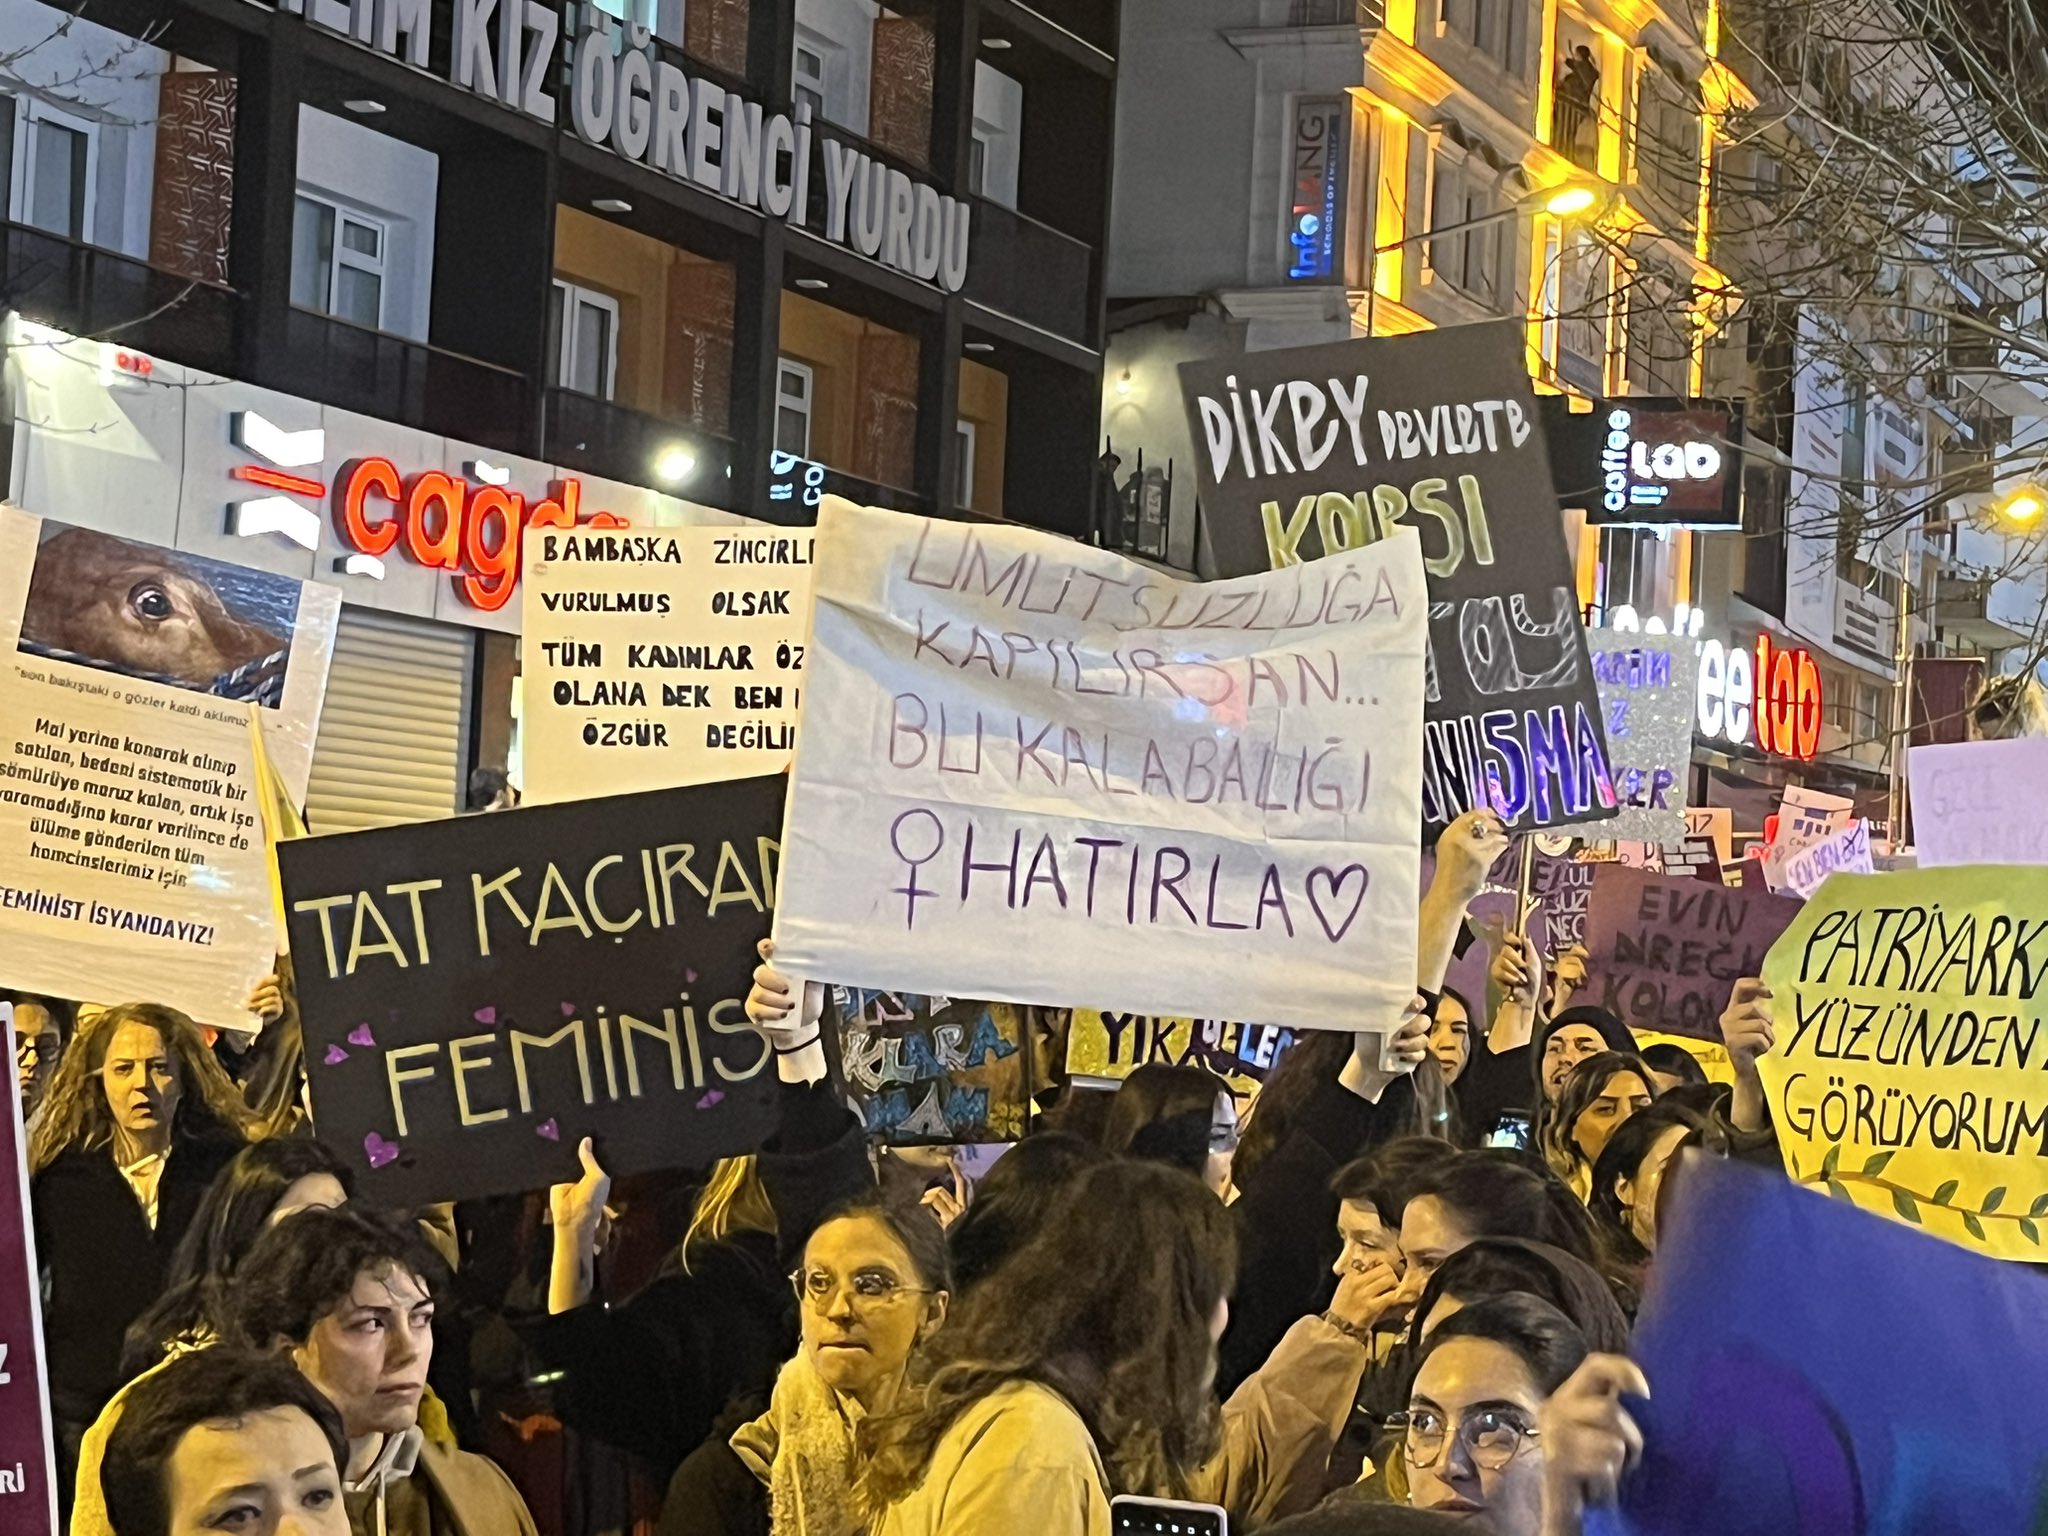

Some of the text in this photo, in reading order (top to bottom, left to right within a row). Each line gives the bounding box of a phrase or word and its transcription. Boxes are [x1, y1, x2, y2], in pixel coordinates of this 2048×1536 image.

[451, 0, 558, 123] KIZ
[572, 3, 812, 226] ÖĞRENCİ
[822, 138, 970, 292] YURDU
[1198, 374, 1531, 484] DİKEY DEVLETE
[543, 536, 682, 566] BAMBAŞKA
[541, 590, 790, 619] VURULMUŞ OLSAK
[541, 636, 602, 667] TÜM
[628, 644, 754, 671] KADINLAR
[553, 680, 647, 706] OLANA
[662, 682, 711, 708] DEK
[734, 686, 782, 709] BEN
[35, 717, 65, 739] Mal
[68, 728, 119, 751] yerine
[124, 735, 189, 766] konarak
[583, 717, 669, 747] ÖZGÜR
[888, 692, 1371, 813] BU KALABALIĞI
[80, 751, 135, 778] bedeni
[138, 765, 222, 797] sistematik
[225, 782, 248, 801] bir
[0, 790, 249, 851] aramadığına karar verilince de
[83, 781, 134, 803] maruz
[189, 803, 227, 822] artık
[30, 841, 154, 881] hemcinslerimiz
[84, 829, 170, 860] gönderilen
[960, 821, 1295, 938] HATIRLA
[89, 900, 214, 946] İSYANDAYIZ!
[295, 878, 443, 979] TAT
[1798, 903, 2048, 1000] PATRİYARK
[1784, 993, 2040, 1070] YÜZÜNDEN
[1784, 1073, 2048, 1157] GÖRÜYORUM
